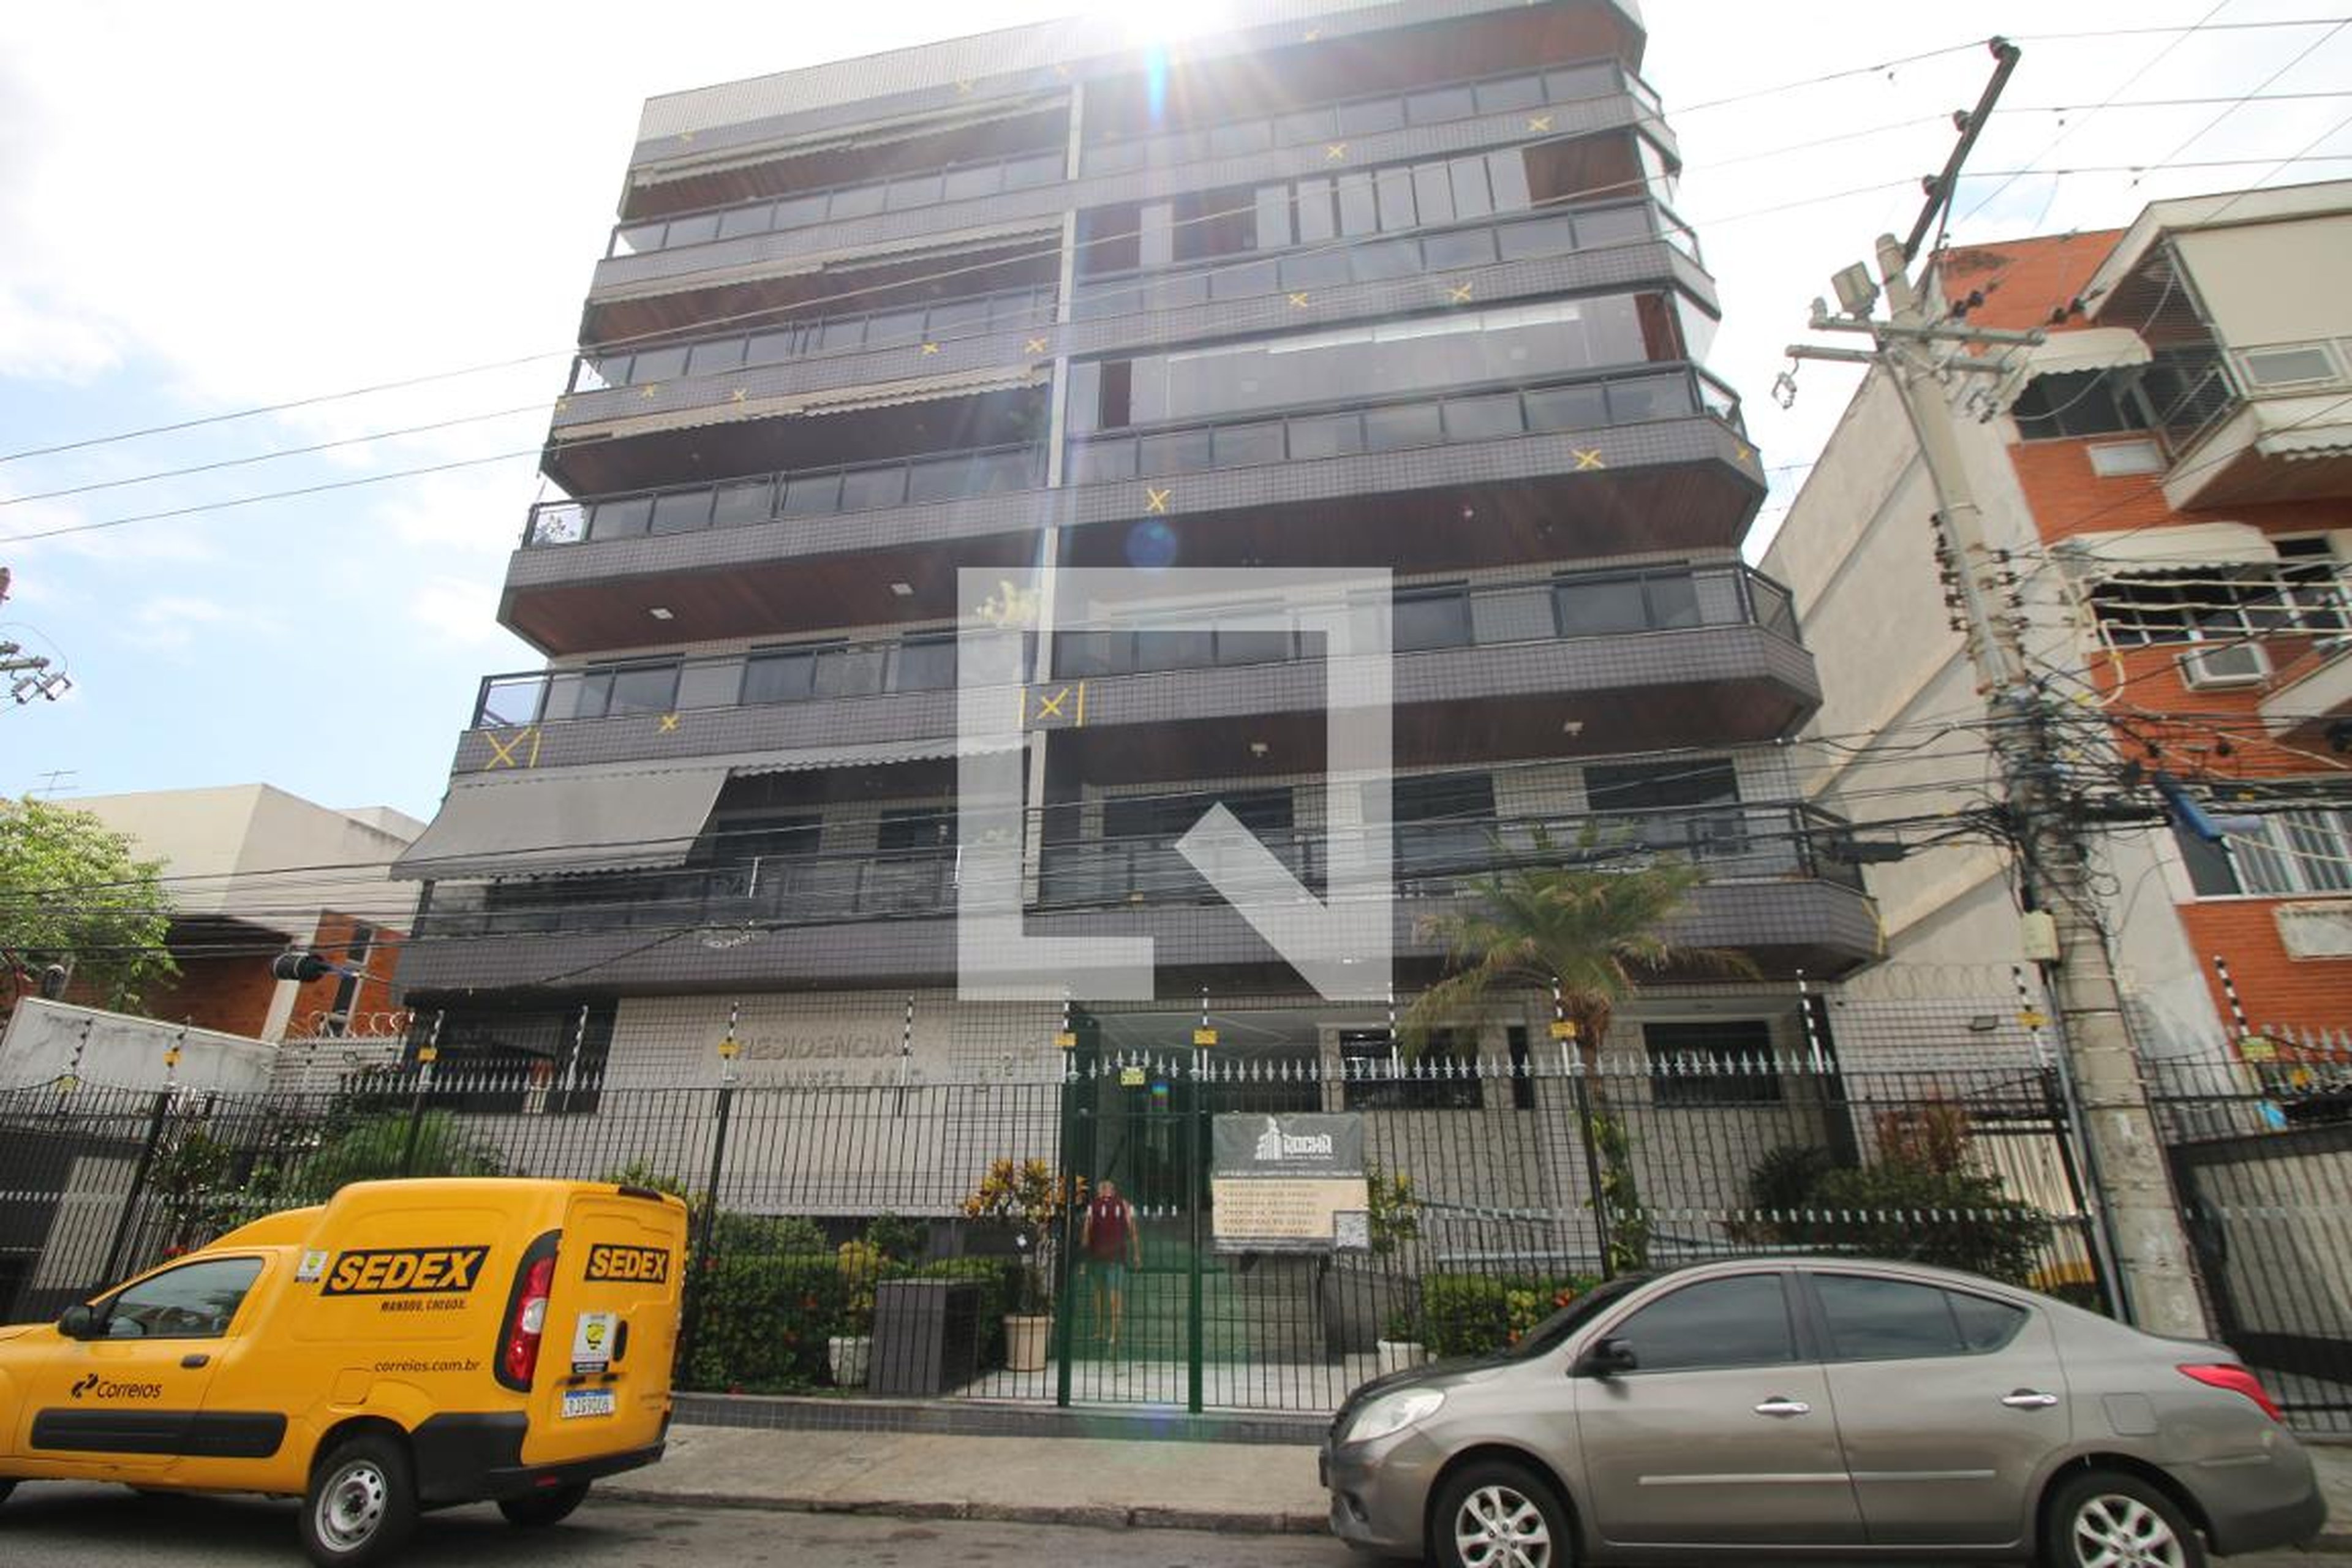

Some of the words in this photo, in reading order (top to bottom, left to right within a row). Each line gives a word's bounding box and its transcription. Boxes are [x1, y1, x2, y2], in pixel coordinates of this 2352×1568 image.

[727, 1035, 913, 1060] ESIDENCIA
[331, 1250, 483, 1292] SEDEX
[589, 1248, 666, 1281] SEDEX
[374, 1358, 480, 1373] correios.com.br
[97, 1381, 163, 1399] Correios
